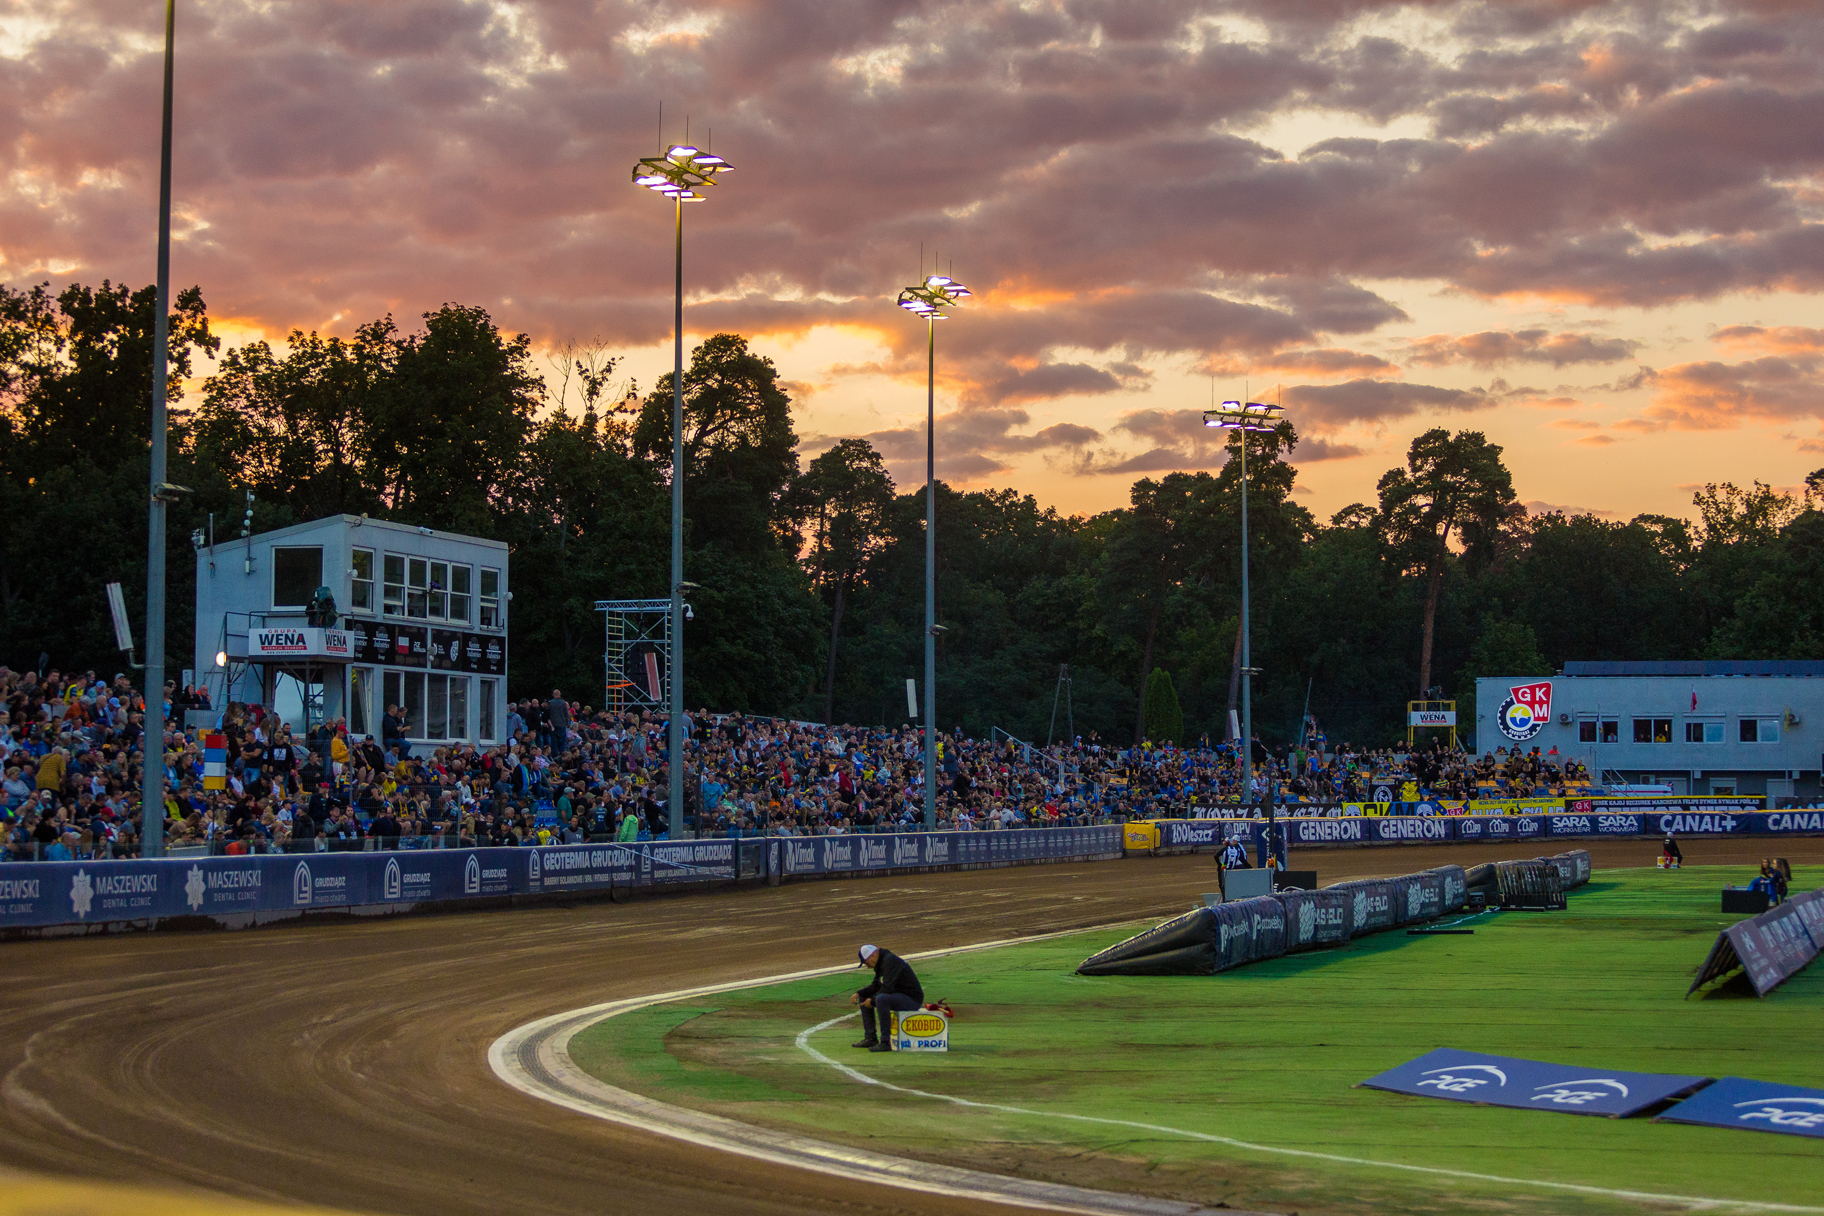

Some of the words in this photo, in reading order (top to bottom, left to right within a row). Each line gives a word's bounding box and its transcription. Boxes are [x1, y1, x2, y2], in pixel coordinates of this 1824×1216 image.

[258, 634, 306, 645] WENA
[325, 634, 347, 647] WENA
[1233, 823, 1250, 834] DPV
[1379, 820, 1445, 838] GENERON
[1552, 816, 1590, 827] SARA
[1598, 816, 1638, 826] SARA
[1660, 815, 1736, 832] CANAL+
[1768, 814, 1824, 830] CANA
[1300, 821, 1361, 840] GENERON
[654, 846, 694, 864] GEOTERMIA
[695, 844, 732, 864] GRUDZIĄDZ
[795, 842, 815, 863] Vimak
[832, 840, 852, 861] Vimak
[868, 839, 886, 859] Vimak
[901, 838, 918, 857] Vimak
[932, 837, 948, 855] Vimak
[544, 851, 590, 870] GEOTERMIA
[96, 874, 157, 895] MASZEWSKI
[208, 870, 262, 888] MASZEWSKI
[315, 876, 346, 888] GRUDZIĄDZ
[103, 898, 127, 908] DENTAL
[130, 897, 151, 907] CLINIC
[214, 893, 235, 901] DENTAL
[237, 891, 256, 900] CLINIC
[10, 903, 33, 914] CLINIC
[906, 1020, 941, 1031] EKOBUD
[918, 1040, 946, 1048] PROFI
